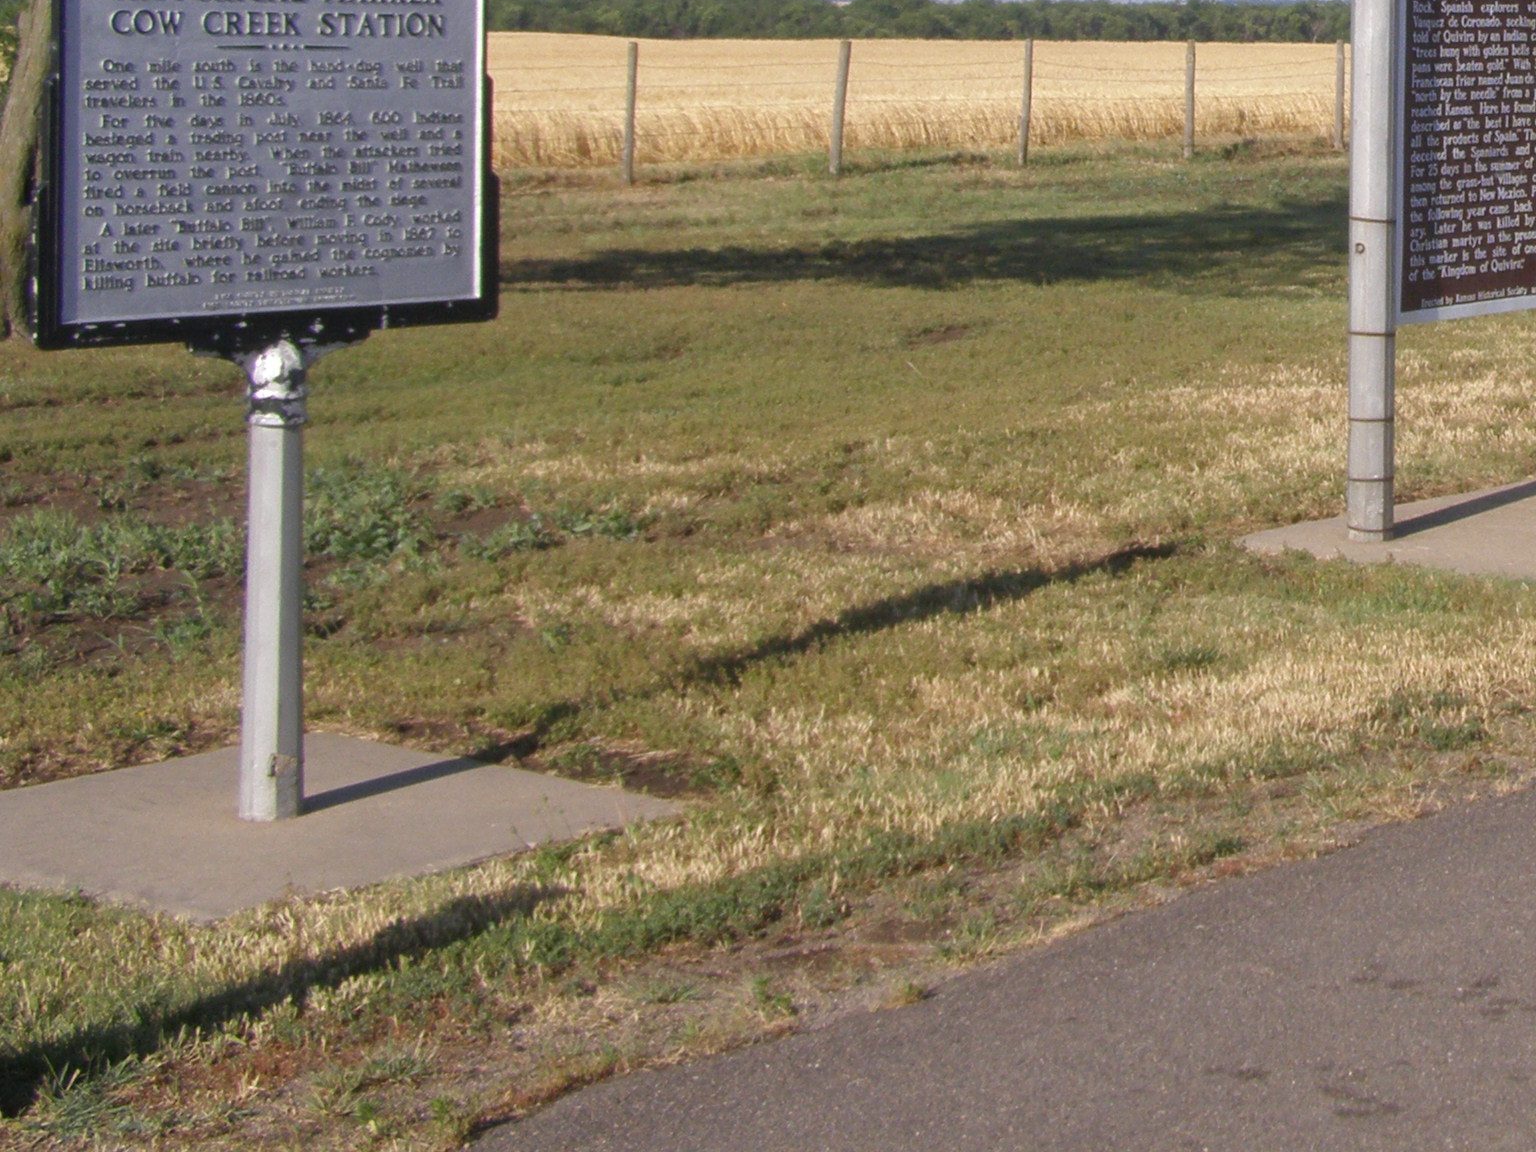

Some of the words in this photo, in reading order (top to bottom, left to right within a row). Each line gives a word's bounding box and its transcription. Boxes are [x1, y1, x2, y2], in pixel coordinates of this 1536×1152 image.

[1441, 1, 1473, 15] Spanish
[1481, 1, 1519, 15] explorers
[110, 9, 183, 35] COW
[201, 10, 300, 37] CREEK
[317, 12, 446, 37] STATION
[1448, 15, 1458, 27] de
[1506, 15, 1536, 30] seeking
[1413, 31, 1428, 43] told
[1432, 31, 1441, 43] of
[1443, 30, 1475, 43] Quivira
[1478, 30, 1488, 43] by
[1503, 30, 1527, 41] Indian
[1483, 44, 1509, 59] golden
[101, 59, 134, 73] One
[148, 58, 180, 72] mile
[193, 58, 235, 72] south
[249, 58, 261, 72] is
[273, 59, 297, 72] the
[397, 59, 422, 72] well
[435, 59, 463, 72] that
[85, 77, 137, 90] served
[153, 77, 179, 90] the
[236, 76, 294, 91] Cavalry
[307, 77, 335, 89] and
[348, 76, 387, 89] Santa
[400, 77, 418, 89] Fe
[429, 75, 463, 89] Trail
[85, 94, 156, 108] travelers
[171, 94, 184, 107] in
[201, 94, 224, 107] the
[101, 114, 128, 128] For
[146, 114, 174, 127] five
[189, 114, 223, 129] days
[239, 114, 252, 126] in
[370, 111, 401, 124] 600
[413, 110, 462, 123] Indians
[83, 132, 154, 148] besieged
[166, 135, 176, 144] a
[189, 131, 243, 147] trading
[255, 130, 286, 144] post
[298, 132, 331, 142] near
[343, 128, 367, 141] the
[381, 128, 407, 140] well
[418, 128, 443, 140] and
[453, 130, 462, 139] a
[85, 151, 134, 166] wagon
[147, 149, 183, 162] train
[269, 147, 310, 159] When
[322, 147, 343, 158] the
[354, 146, 418, 157] attackers
[428, 145, 462, 156] tried
[85, 168, 101, 181] to
[114, 168, 175, 180] overrun
[190, 166, 214, 178] the
[84, 185, 123, 199] fired
[135, 188, 144, 197] a
[158, 183, 192, 197] field
[204, 184, 256, 195] cannon
[267, 180, 296, 193] into
[306, 179, 329, 192] the
[388, 177, 402, 190] of
[412, 176, 461, 189] several
[84, 205, 103, 216] on
[114, 200, 193, 215] horseback
[205, 199, 232, 212] and
[298, 197, 346, 211] ending
[357, 195, 379, 207] the
[100, 222, 112, 237] A
[123, 222, 159, 236] later
[287, 215, 336, 229] William
[413, 210, 461, 224] worked
[1434, 222, 1456, 234] Later
[83, 243, 99, 255] at
[113, 240, 140, 254] the
[152, 239, 179, 251] site
[191, 236, 242, 251] briefly
[256, 234, 303, 247] before
[315, 231, 367, 246] moving
[378, 230, 392, 241] in
[446, 227, 461, 238] to
[1410, 239, 1448, 252] Christian
[1452, 235, 1482, 248] martyr
[184, 254, 231, 267] where
[241, 251, 261, 265] he
[270, 250, 320, 266] gained
[331, 248, 354, 260] the
[363, 245, 434, 261] cognomen
[443, 243, 460, 257] by
[82, 276, 134, 291] killing
[145, 273, 201, 288] buffalo
[211, 270, 235, 283] for
[246, 268, 305, 282] railroad
